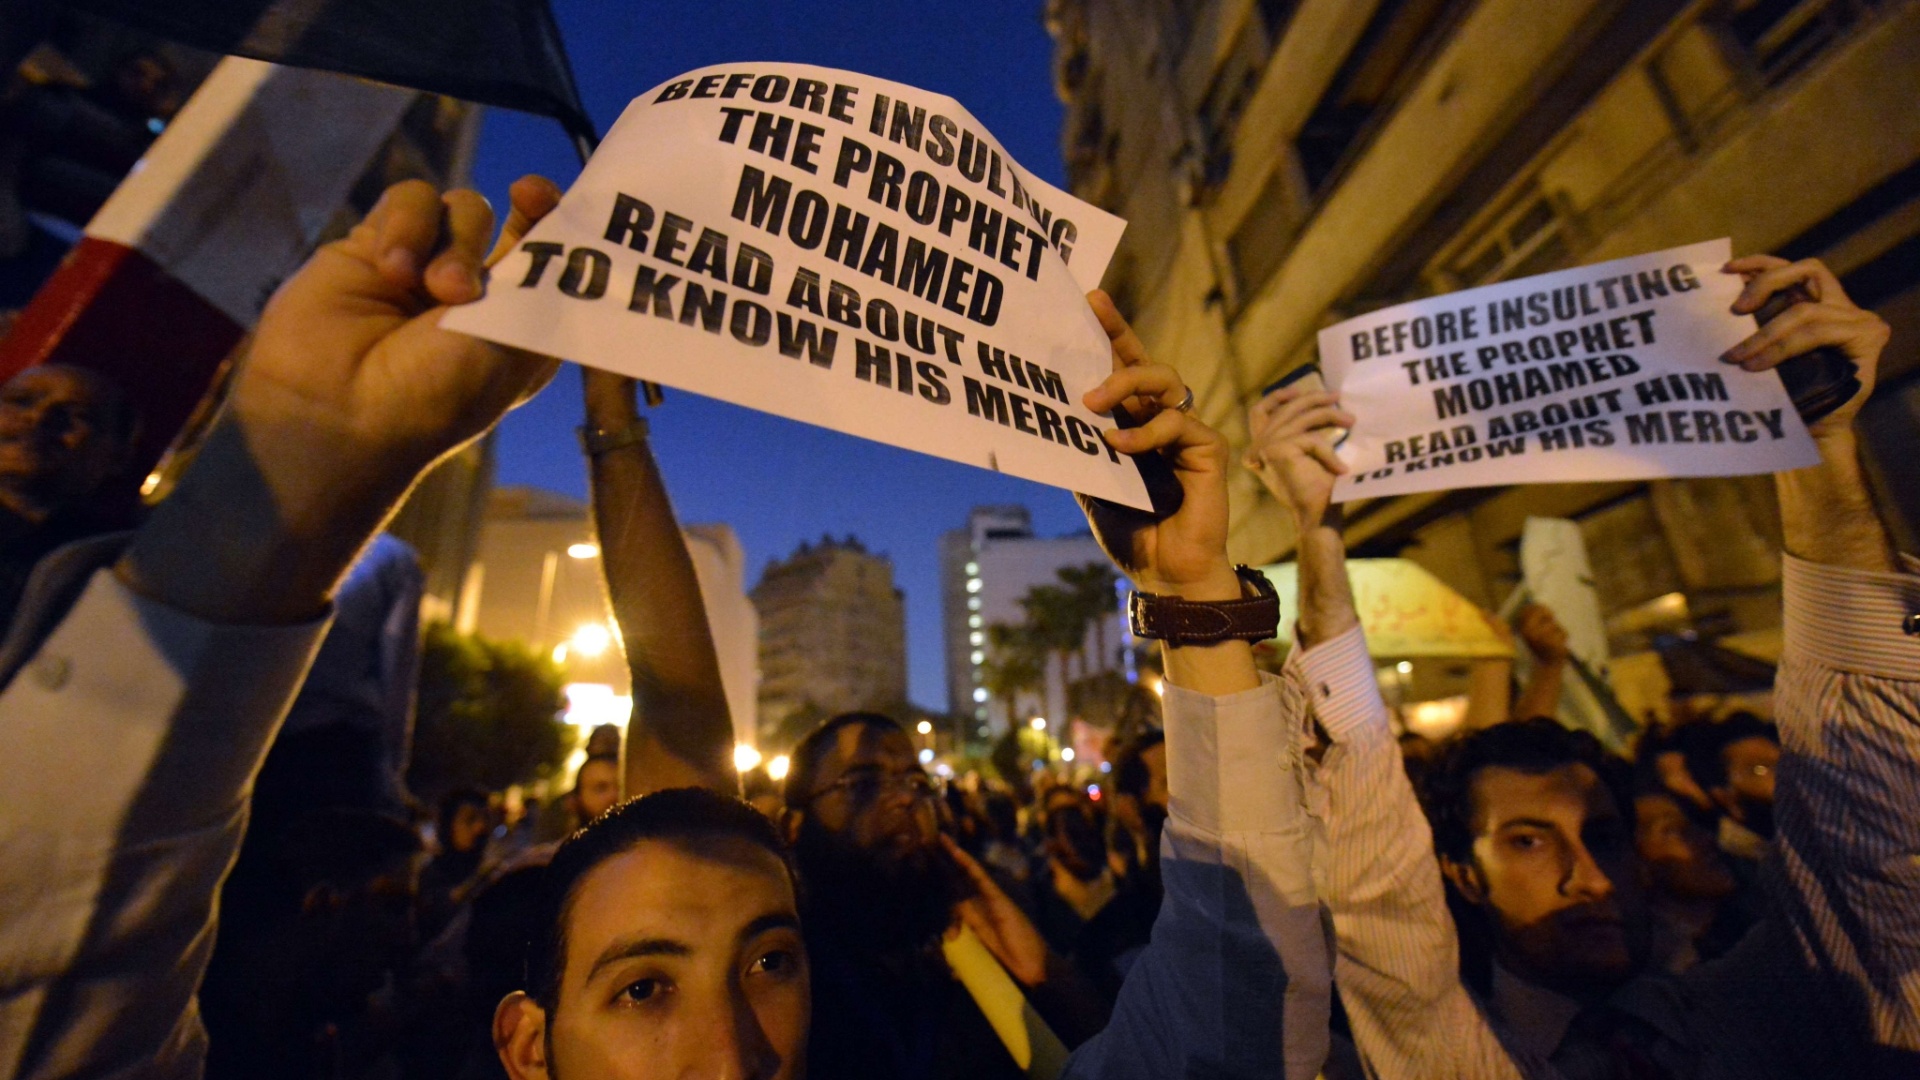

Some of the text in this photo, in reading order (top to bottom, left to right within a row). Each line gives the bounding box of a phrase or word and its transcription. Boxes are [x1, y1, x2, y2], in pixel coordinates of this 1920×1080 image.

[652, 73, 1077, 267] BEFORE INSULTNG
[719, 107, 1048, 282] THE PROPHET
[604, 192, 1070, 405] READ ABOUT HIM
[731, 164, 1004, 327] MOHAMED
[518, 241, 1121, 465] TO KNOW HIS MERCY
[1351, 264, 1700, 361] BEFORE INSULTING
[1402, 310, 1656, 385] THE PROPHET
[1353, 408, 1785, 484] TO KNOW HIS MERCY
[1384, 372, 1729, 464] READ ABOUT HIM
[1433, 354, 1640, 420] MOHAMED
